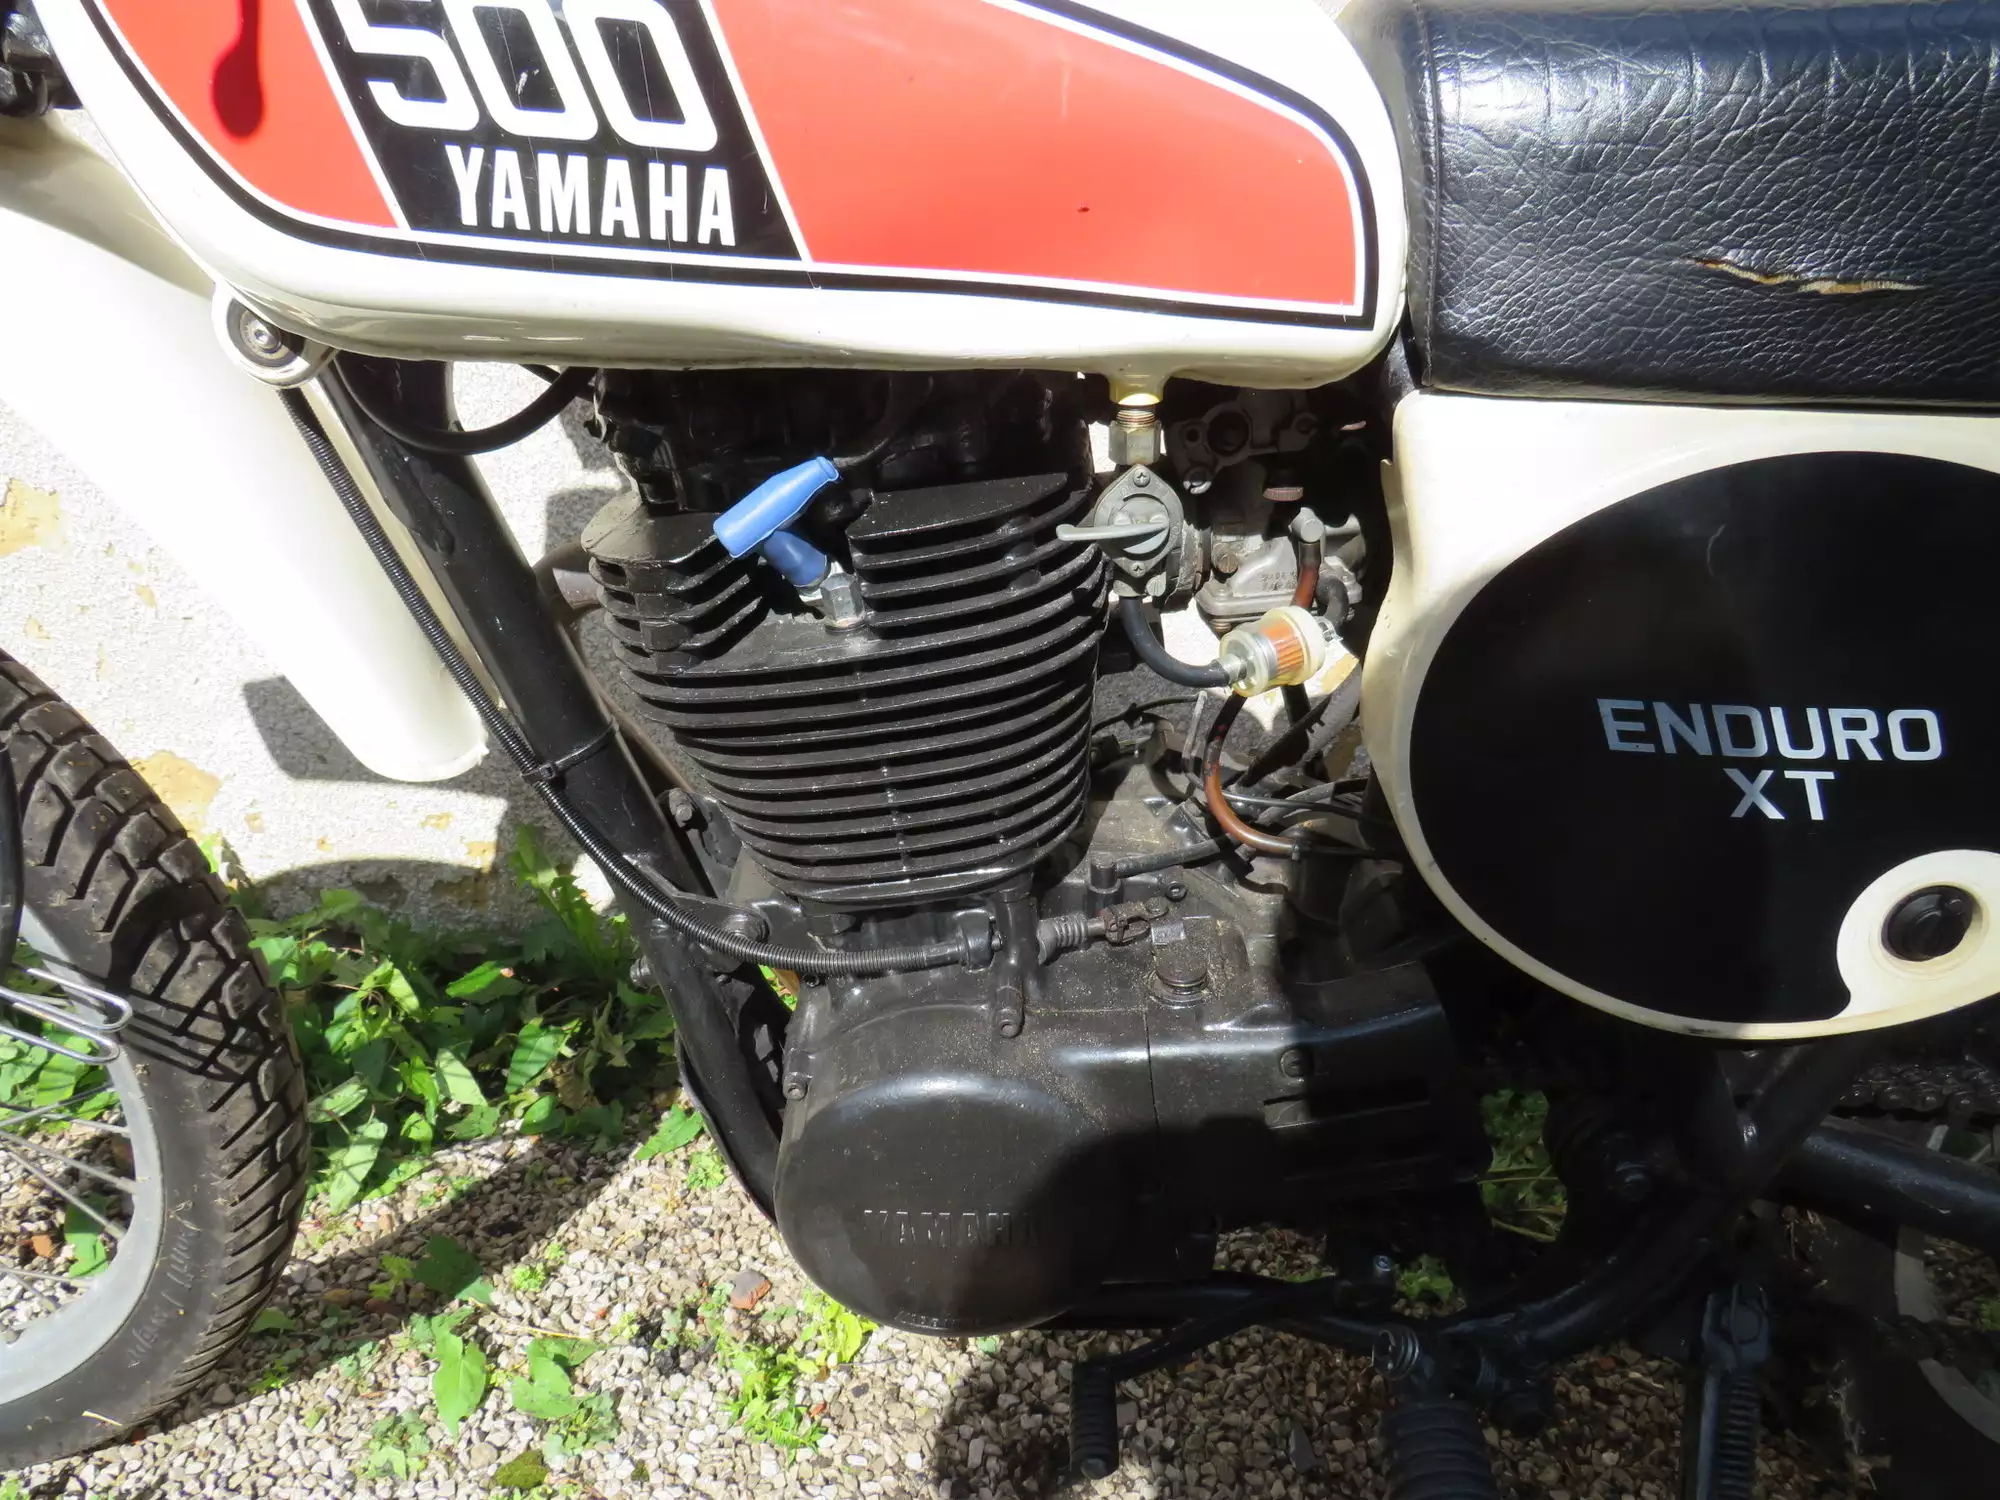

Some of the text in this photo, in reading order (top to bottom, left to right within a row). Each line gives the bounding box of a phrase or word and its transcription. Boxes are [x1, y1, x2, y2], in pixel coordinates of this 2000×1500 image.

[332, 0, 718, 151] 500
[446, 144, 736, 247] YAMAHA
[1598, 698, 1943, 761] ENDURO
[1725, 768, 1836, 820] XT
